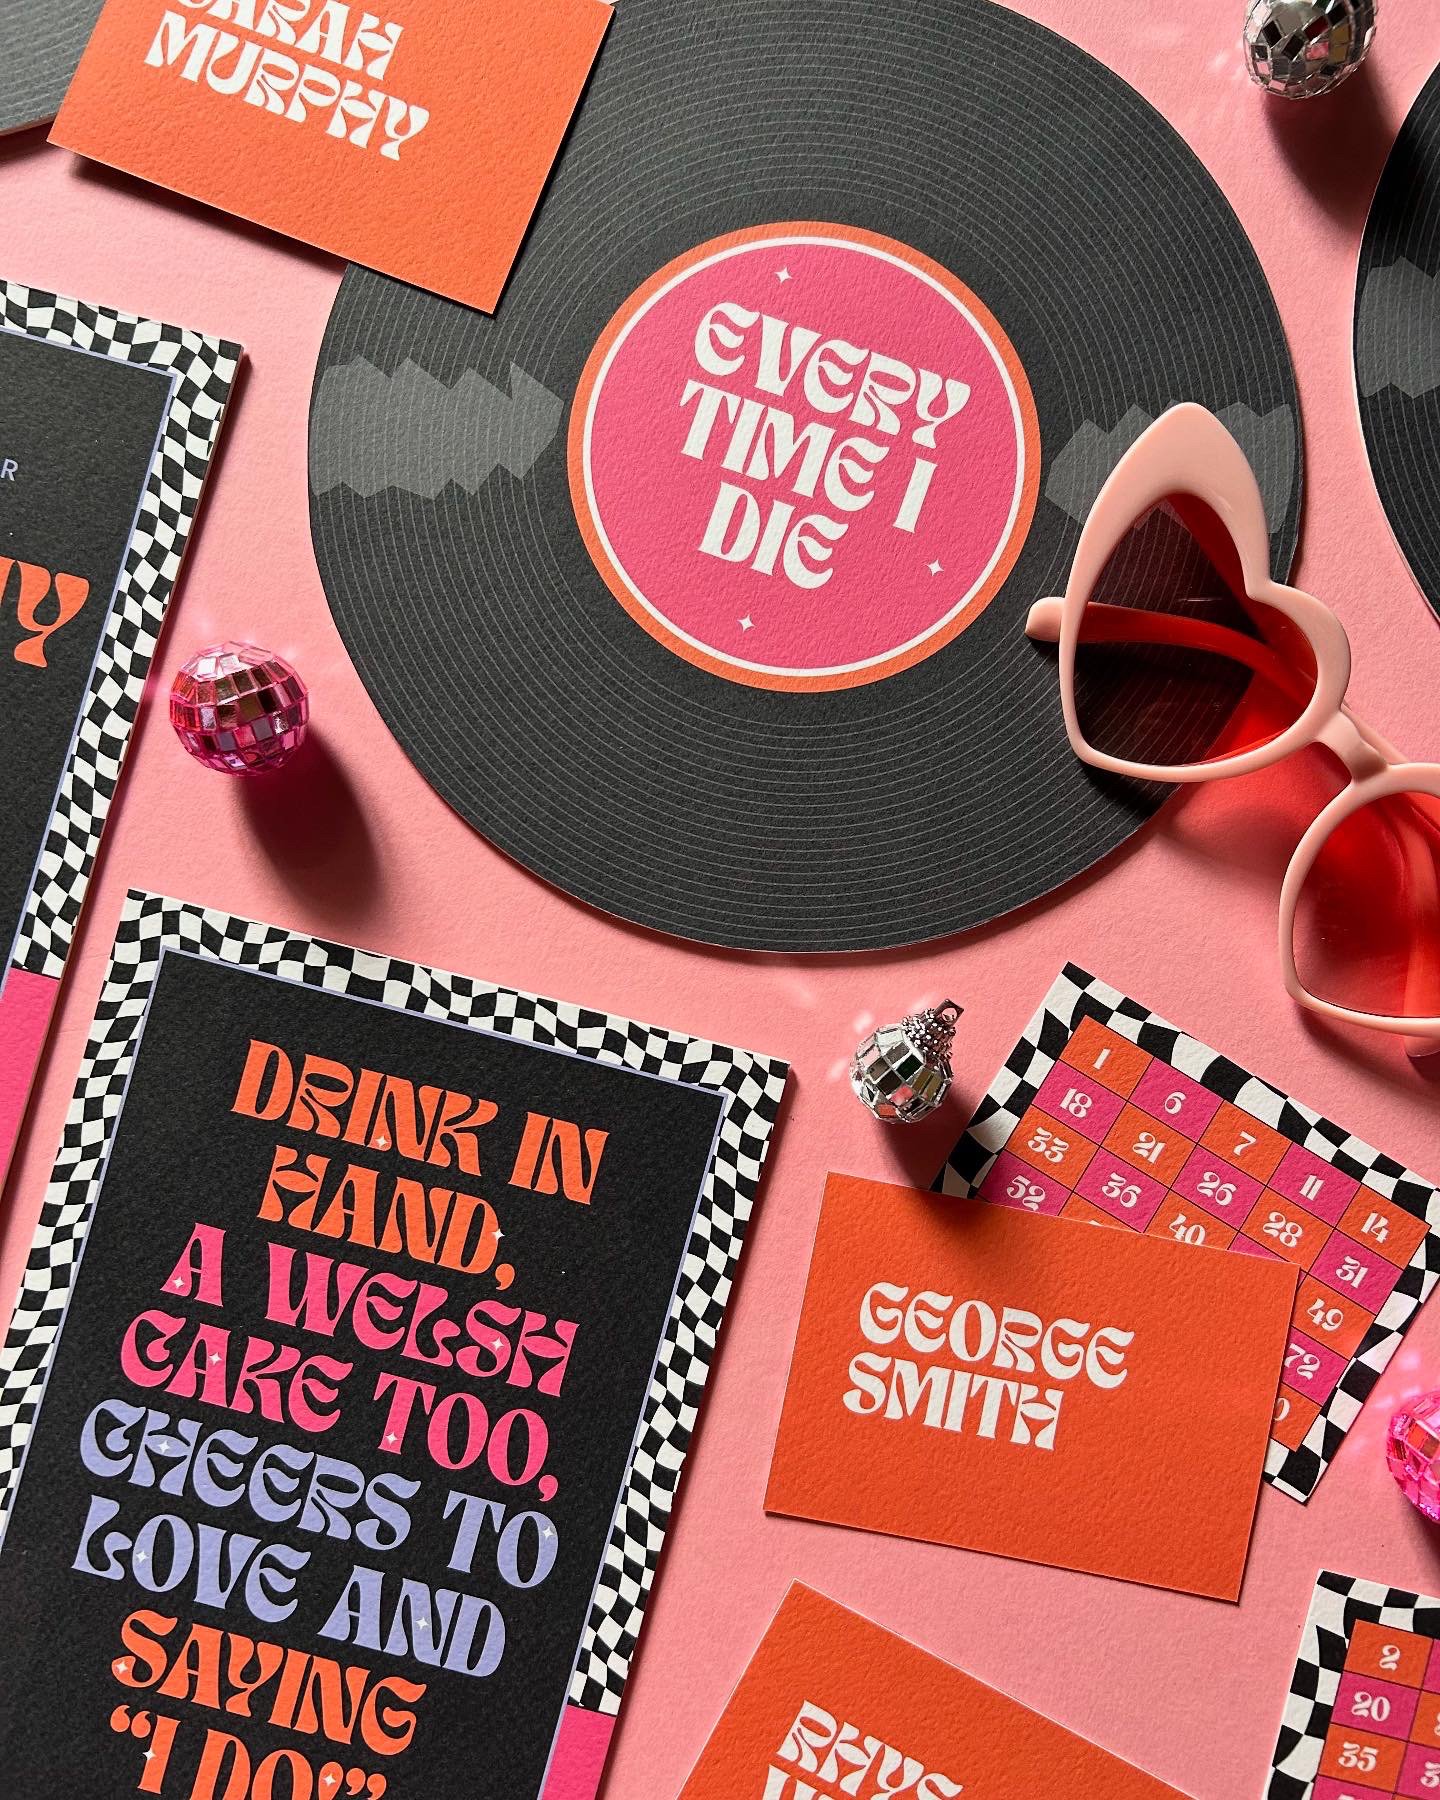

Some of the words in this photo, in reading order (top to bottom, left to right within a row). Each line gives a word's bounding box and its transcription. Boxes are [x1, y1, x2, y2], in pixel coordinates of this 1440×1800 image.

[177, 0, 404, 80] ARAH
[144, 10, 429, 160] MURPHY
[695, 302, 970, 449] EVERY
[679, 379, 889, 511] TIME
[892, 457, 938, 533] I
[698, 481, 848, 589] DIE
[0, 555, 90, 668] Y
[1093, 1049, 1111, 1070] 1
[1060, 1088, 1093, 1118] 18
[1165, 1092, 1187, 1115] 6
[231, 1039, 498, 1176] DRINK
[507, 1112, 609, 1205] IN
[1027, 1127, 1069, 1163] 33
[1132, 1132, 1166, 1164] 21
[1234, 1131, 1257, 1156] 7
[1006, 1174, 1046, 1211] 52
[1101, 1172, 1142, 1208] 36
[1197, 1171, 1237, 1206] 26
[1300, 1174, 1324, 1200] 11
[257, 1145, 514, 1290] HAND,
[1169, 1213, 1206, 1246] 40
[1263, 1211, 1303, 1248] 28
[1361, 1212, 1389, 1243] 14
[1335, 1255, 1369, 1289] 31
[160, 1223, 227, 1307] A
[266, 1242, 580, 1397] WELSH
[1307, 1298, 1344, 1331] 49
[859, 1281, 1135, 1388] GEORGE
[1284, 1343, 1320, 1380] 72
[120, 1310, 355, 1432] CAKE
[374, 1373, 559, 1501] TOO,
[842, 1351, 1063, 1450] SMITH
[80, 1399, 421, 1550] CHEERS
[443, 1490, 559, 1588] TO
[71, 1495, 311, 1622] LOVE
[318, 1565, 506, 1677] AND
[1379, 1644, 1401, 1671] 2
[112, 1610, 427, 1755] SAYING
[1351, 1691, 1391, 1721] 20
[1338, 1741, 1379, 1772] 35
